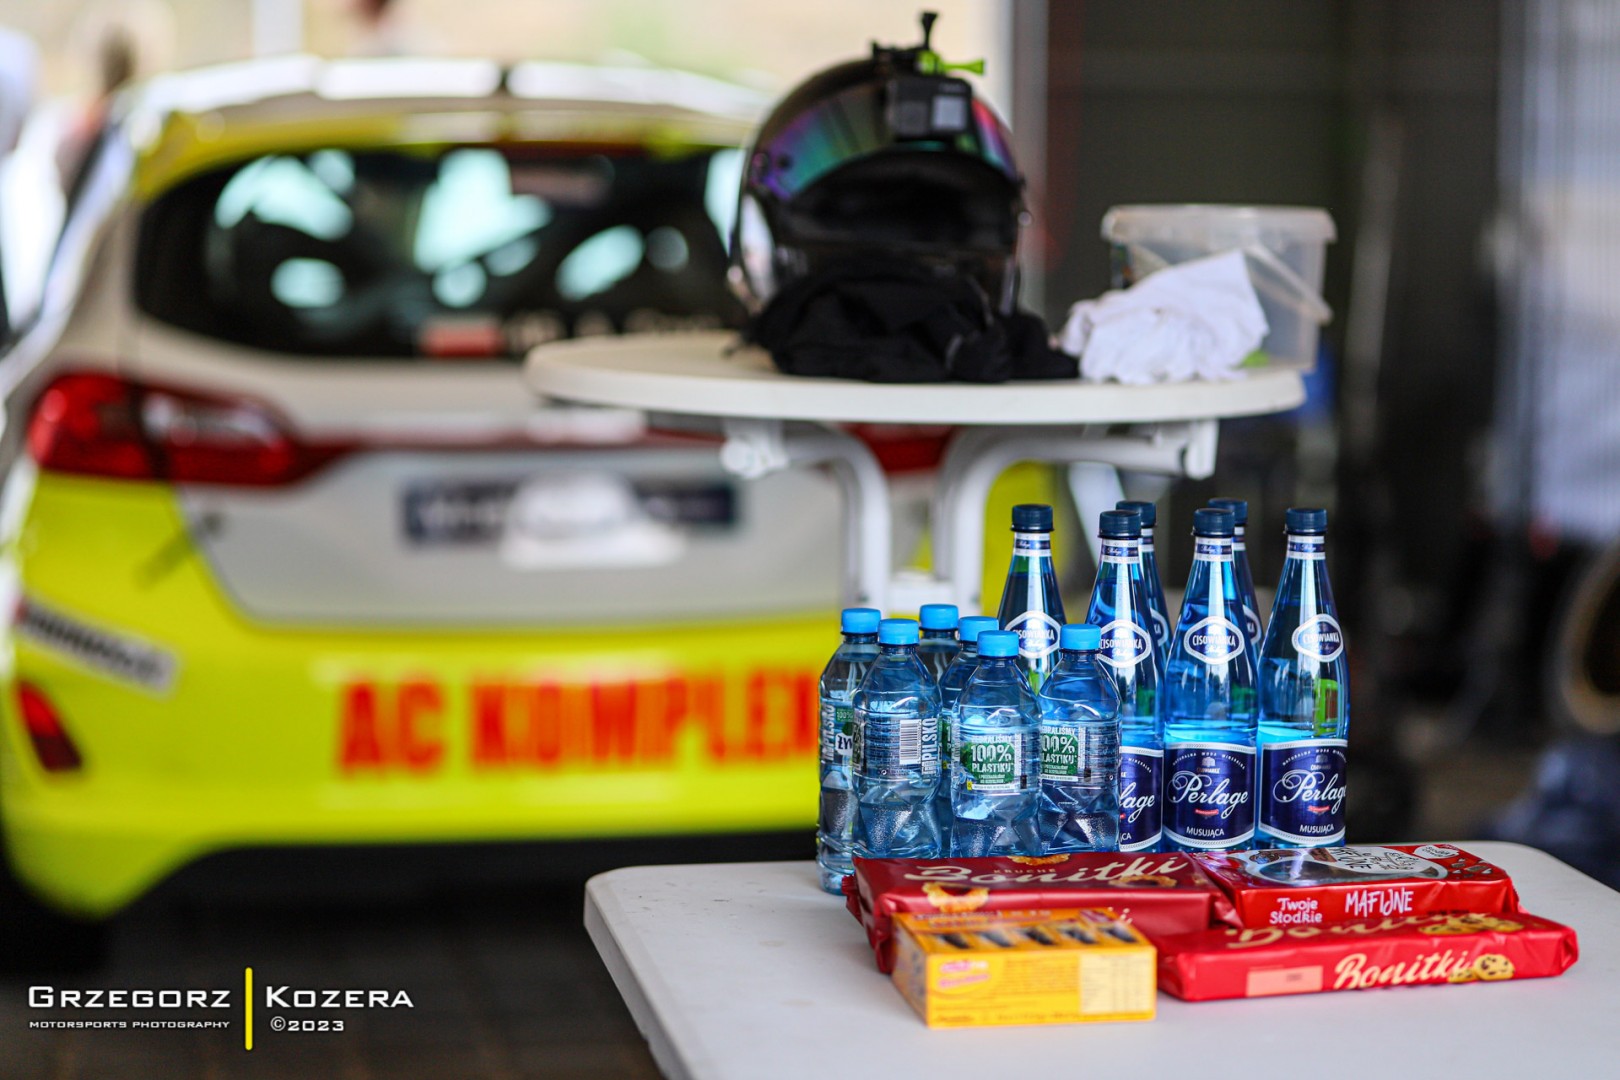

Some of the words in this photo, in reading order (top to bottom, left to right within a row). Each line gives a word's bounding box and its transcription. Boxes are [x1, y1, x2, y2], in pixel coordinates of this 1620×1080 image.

[1192, 634, 1236, 647] CISOWIANKA
[340, 680, 443, 769] AC
[971, 744, 1012, 761] 100%
[1041, 734, 1076, 753] 00%
[1042, 751, 1077, 765] LASTIKU
[1119, 782, 1155, 823] lage
[1167, 770, 1248, 820] Perlage
[1186, 826, 1225, 838] MUSUJĄCA
[903, 856, 1188, 884] Bonitki
[1277, 898, 1319, 912] Twoje
[1345, 887, 1415, 917] MAFIJNE
[1269, 911, 1323, 924] Słodkie
[1333, 949, 1472, 990] Bonitki
